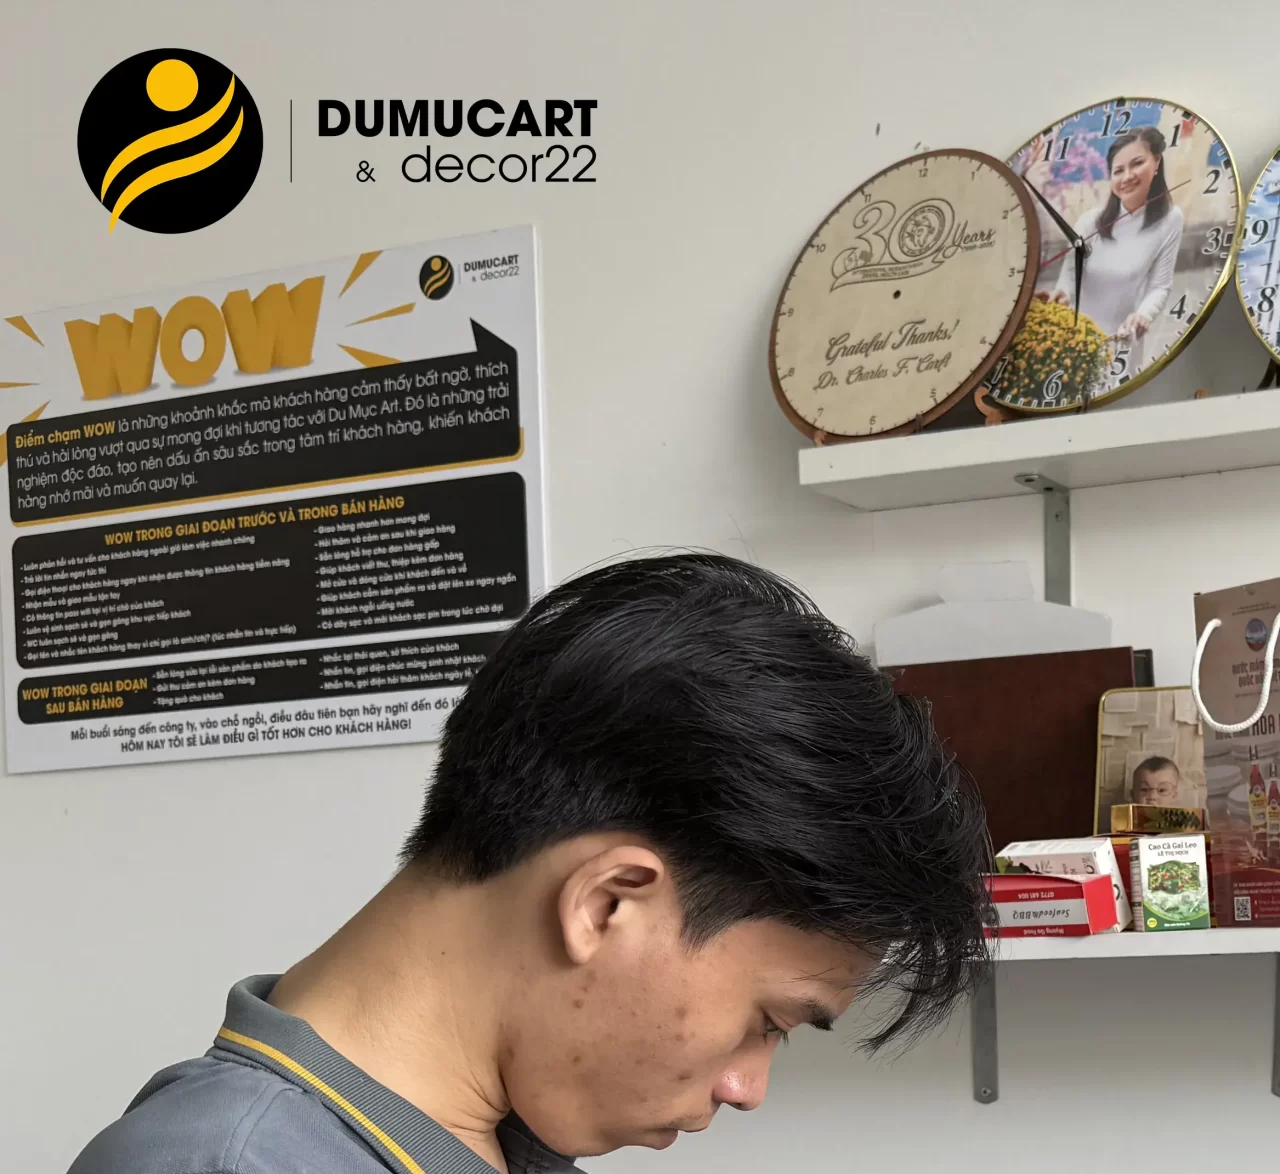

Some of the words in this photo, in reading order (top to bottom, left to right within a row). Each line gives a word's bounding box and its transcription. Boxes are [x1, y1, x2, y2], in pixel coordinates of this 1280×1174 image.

[1100, 111, 1131, 137] 12
[1042, 136, 1071, 162] 11
[943, 220, 996, 258] Years
[1202, 227, 1222, 254] 3
[464, 254, 519, 272] DUMUCART
[480, 265, 520, 281] decor22
[64, 275, 325, 400] WOW
[825, 331, 893, 366] Grateful
[891, 318, 960, 350] Thanks!
[813, 370, 839, 390] Dr.
[845, 364, 888, 385] Charles
[892, 356, 918, 377] F.
[14, 428, 45, 449] Điểm
[47, 428, 81, 445] chạm
[83, 420, 115, 438] WOW
[118, 418, 129, 433] là
[131, 414, 168, 430] những
[170, 405, 214, 424] khoảnh
[217, 399, 247, 417] khắc
[250, 396, 271, 412] mà
[273, 390, 312, 409] khách
[314, 386, 348, 402] hàng
[350, 379, 381, 397] cảm
[383, 373, 412, 392] thấy
[415, 369, 438, 388] bất
[441, 366, 471, 386] ngờ,
[474, 361, 508, 378] thích
[15, 453, 34, 469] thú
[35, 451, 50, 466] và
[52, 443, 70, 463] hài
[71, 446, 96, 461] lòng
[98, 439, 124, 457] vượt
[126, 438, 150, 454] qua
[152, 434, 165, 450] sự
[166, 430, 201, 446] mong
[203, 424, 223, 442] đợi
[225, 422, 242, 437] khi
[244, 418, 280, 434] tương
[282, 413, 304, 428] tác
[306, 409, 326, 425] với
[328, 407, 346, 422] Du
[348, 403, 377, 420] Mục
[380, 398, 402, 415] Art.
[404, 394, 424, 411] Đó
[427, 392, 440, 408] là
[442, 388, 485, 405] những
[487, 381, 509, 399] trải
[104, 531, 133, 545] WOW
[135, 525, 173, 542] TRONG
[175, 522, 199, 536] GIAI
[202, 517, 235, 533] ĐOẠN
[237, 511, 276, 528] TRƯỚC
[278, 507, 296, 523] VÀ
[298, 504, 338, 520] TRONG
[341, 499, 366, 515] BÁN
[368, 495, 404, 512] HÀNG
[22, 687, 50, 700] WOW
[51, 683, 88, 699] TRONG
[90, 681, 113, 696] GIAI
[115, 677, 147, 693] ĐOẠN
[46, 702, 65, 714] SAU
[68, 698, 90, 713] BÁN
[92, 695, 124, 710] HÀNG
[120, 736, 144, 752] HÔM
[146, 739, 166, 750] NAY
[167, 733, 184, 748] TÔI
[186, 733, 197, 747] SẼ
[199, 732, 220, 746] LÀM
[222, 728, 244, 744] ĐIỀU
[247, 728, 259, 742] GÌ
[260, 725, 280, 741] TỐT
[282, 726, 305, 739] HƠN
[308, 724, 332, 737] CHO
[335, 720, 373, 735] KHÁCH
[376, 717, 411, 732] HÀNG!
[1012, 907, 1070, 920] Seafood&BBQ
